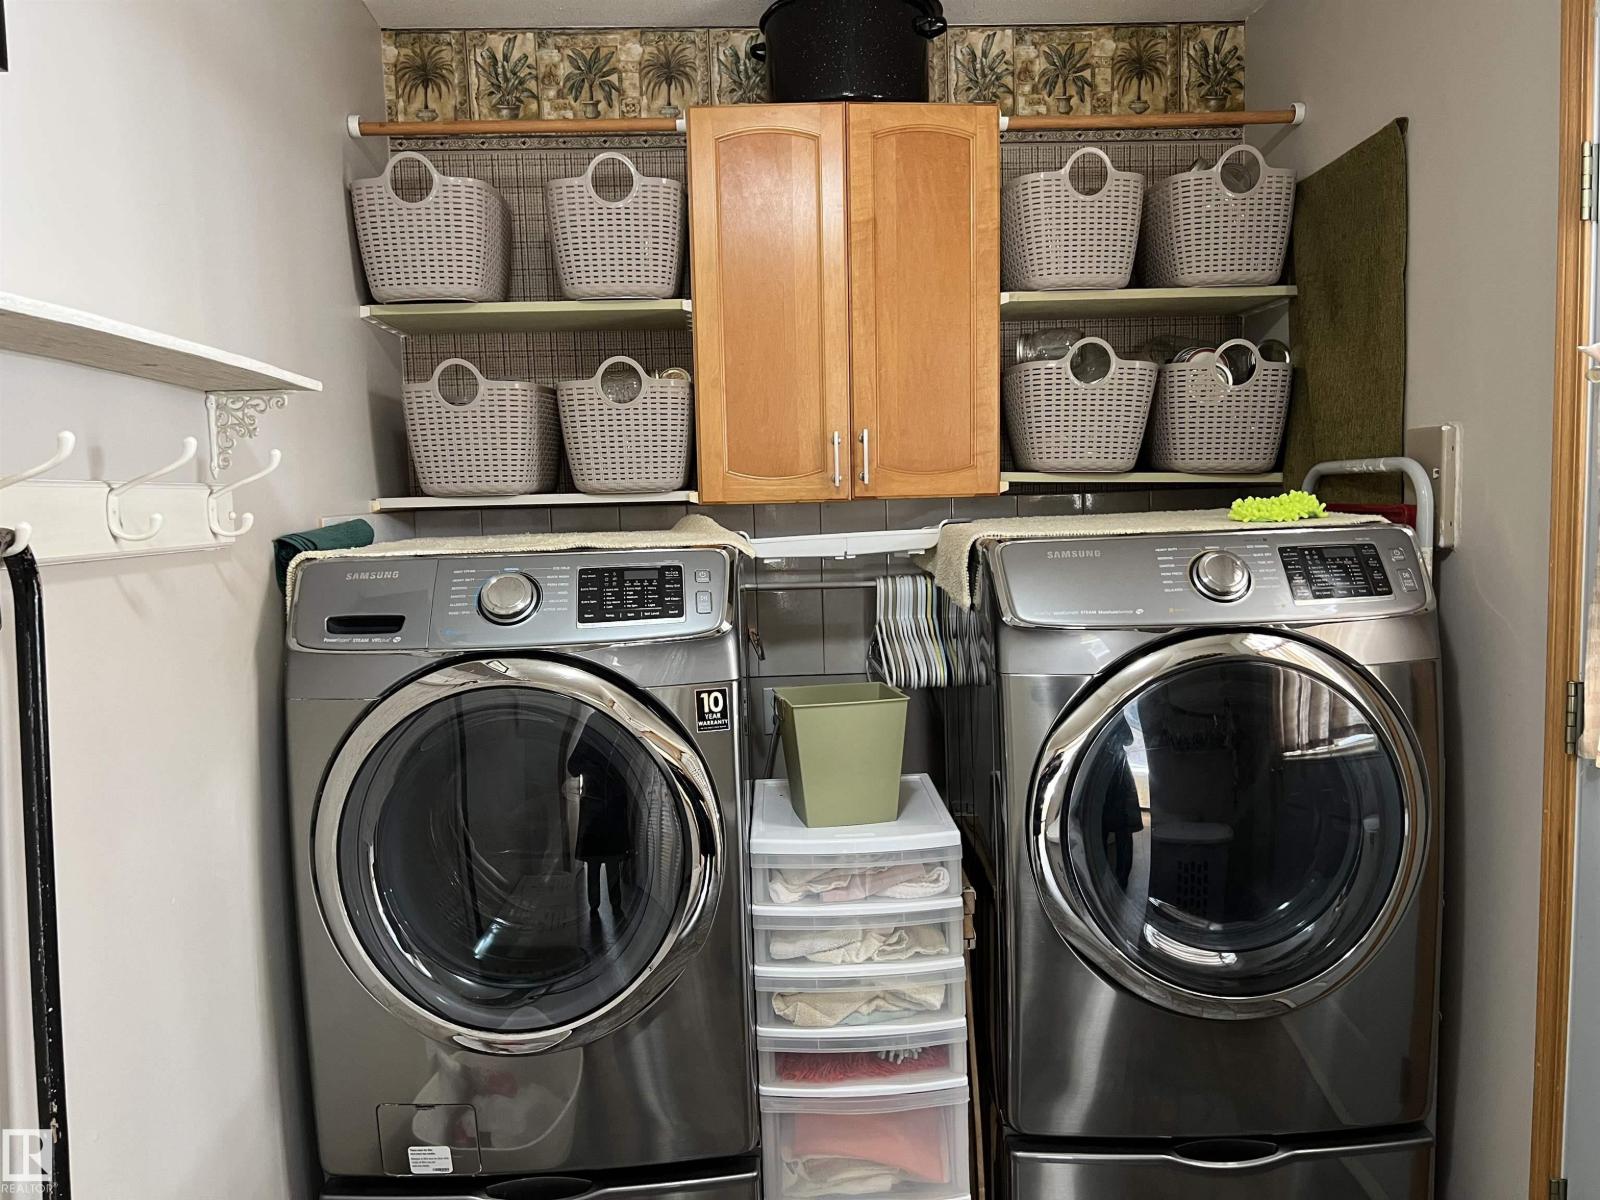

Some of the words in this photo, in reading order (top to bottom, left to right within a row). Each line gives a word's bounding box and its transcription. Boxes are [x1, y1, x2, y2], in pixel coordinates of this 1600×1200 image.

[1047, 550, 1101, 559] SAMSUNG
[346, 570, 399, 580] SAMSUNG
[700, 692, 724, 713] 10
